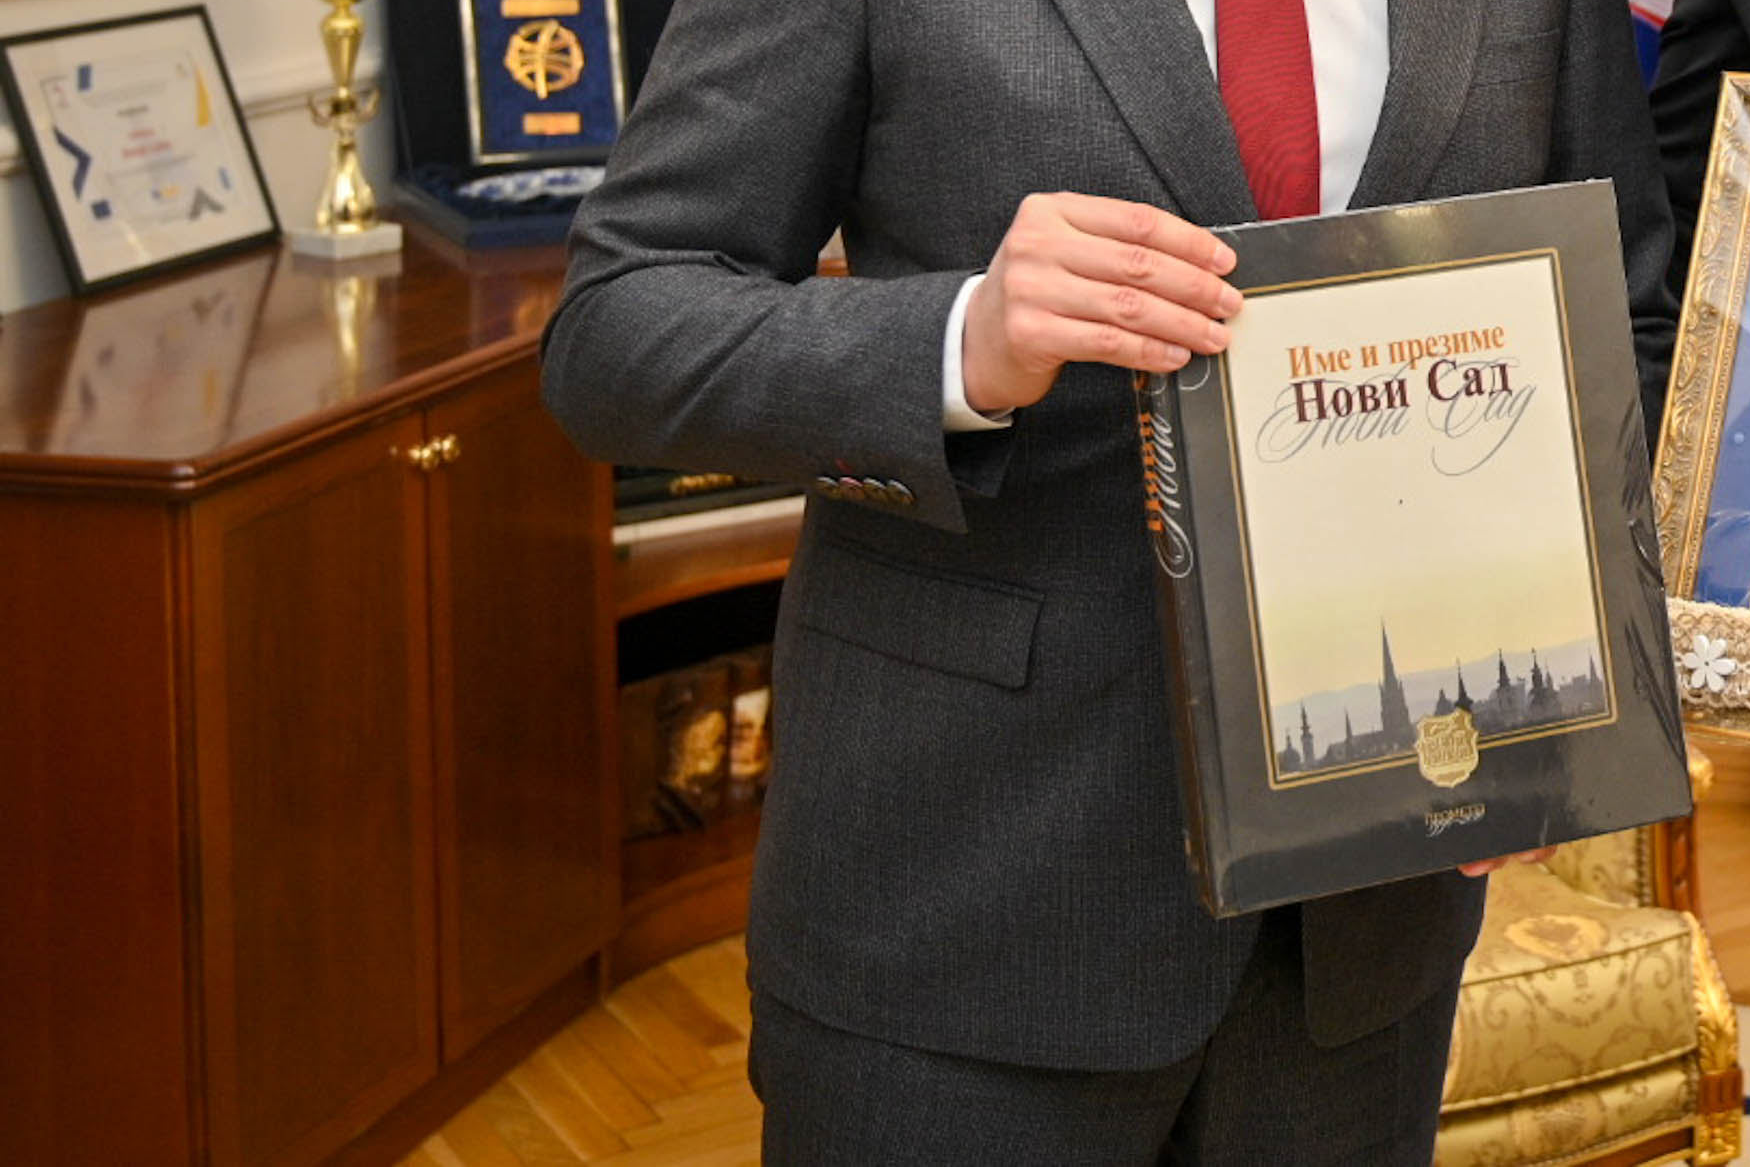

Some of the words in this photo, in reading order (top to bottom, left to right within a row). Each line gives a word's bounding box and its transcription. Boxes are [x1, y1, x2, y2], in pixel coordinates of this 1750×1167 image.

[1287, 345, 1351, 378] Име
[1361, 345, 1379, 368] и
[1388, 325, 1505, 370] презиме
[1292, 378, 1410, 424] Нови
[1427, 359, 1513, 402] Сад
